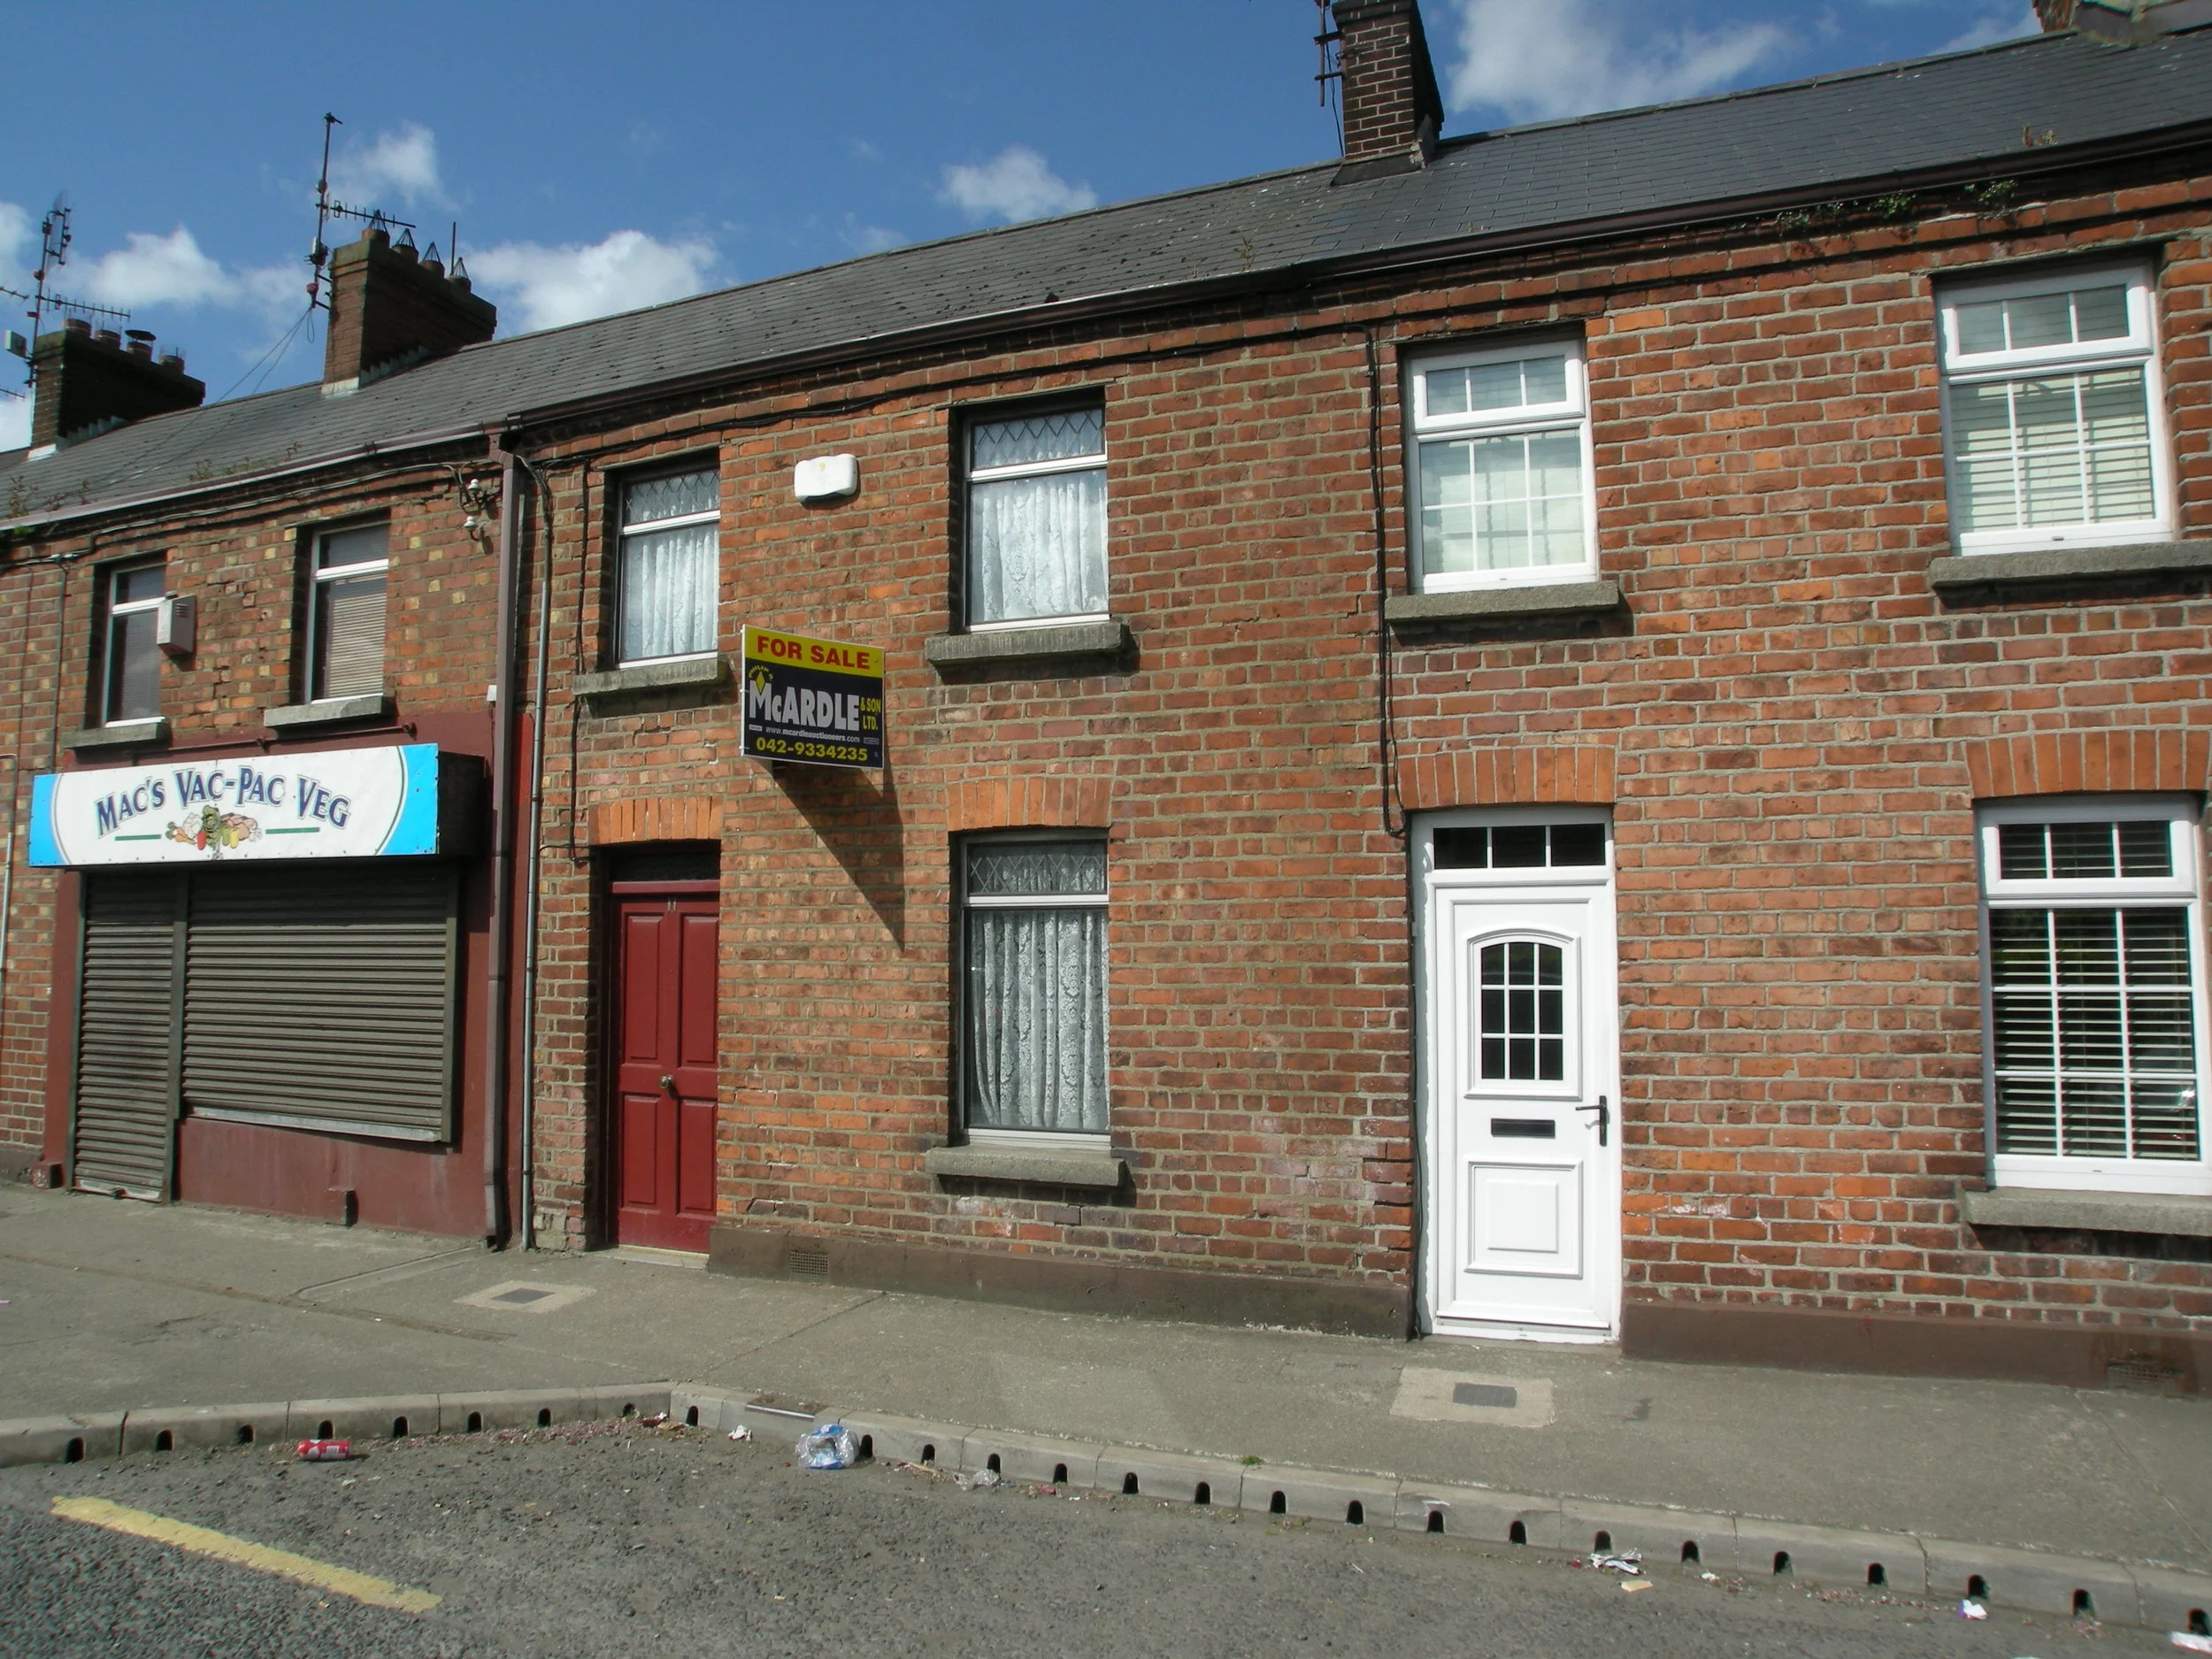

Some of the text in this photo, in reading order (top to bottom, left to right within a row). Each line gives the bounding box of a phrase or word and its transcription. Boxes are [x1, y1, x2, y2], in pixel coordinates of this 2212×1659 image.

[757, 635, 870, 670] FOR SALE
[749, 680, 859, 732] McARDLE
[860, 697, 881, 712] & SON
[756, 736, 868, 762] 042-9334235
[765, 726, 860, 743] www.mcardleauctioneers.com
[96, 764, 352, 839] MAC'S VAC-PAC VEG
